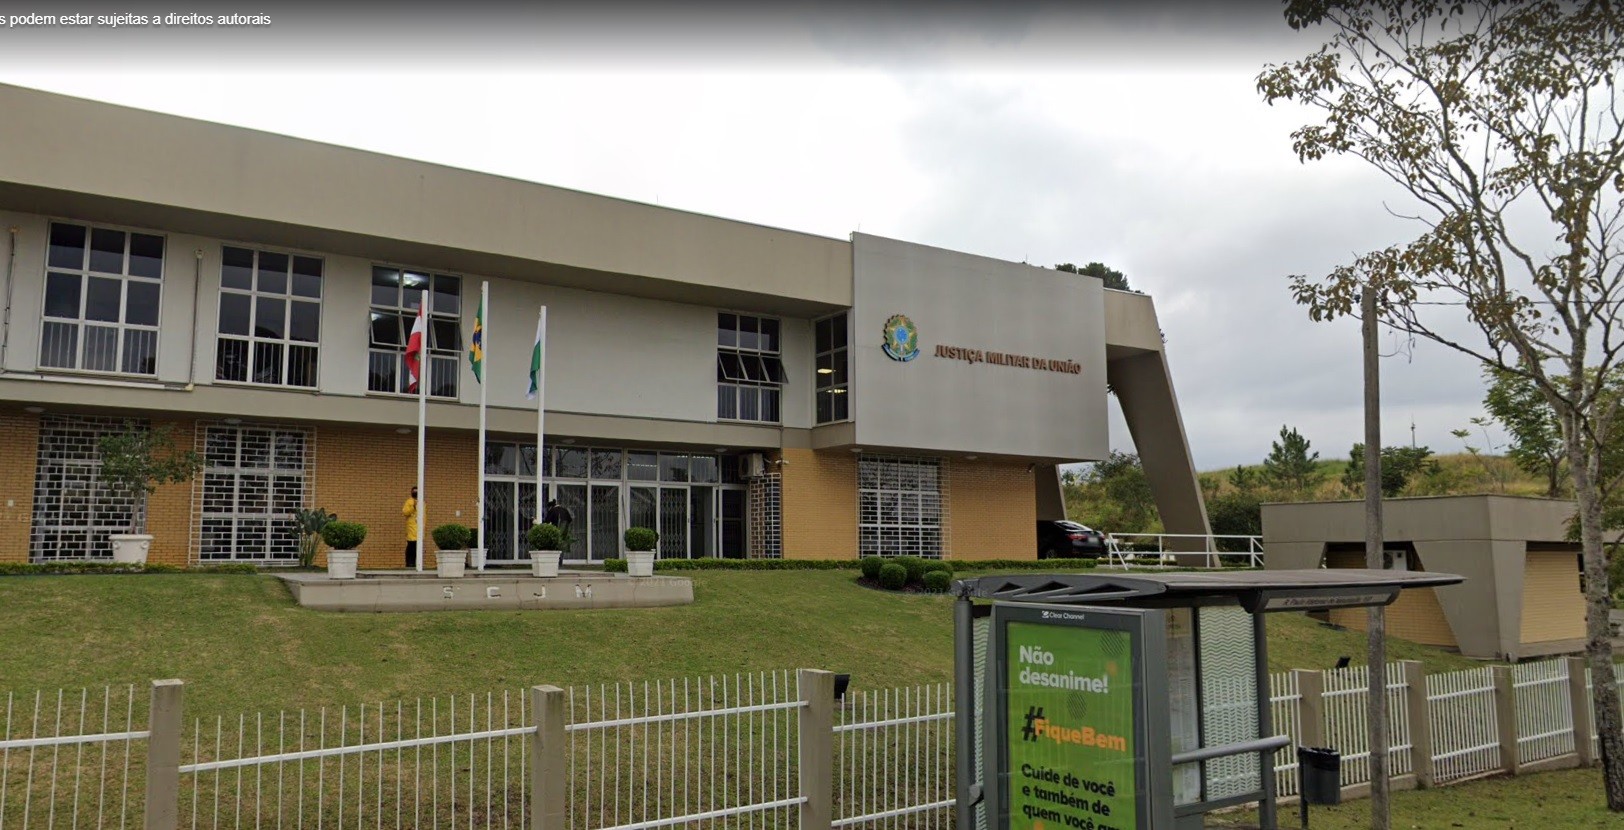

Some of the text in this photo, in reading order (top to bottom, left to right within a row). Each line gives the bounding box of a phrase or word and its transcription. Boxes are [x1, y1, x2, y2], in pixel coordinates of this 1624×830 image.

[934, 344, 1082, 375] JUSTIÇA MILITAR DA UNIÃO
[1049, 611, 1084, 620] Clear Channel
[1020, 645, 1054, 665] Não
[1020, 666, 1108, 693] desanime!
[1021, 706, 1126, 752] #FiqueBem
[1021, 763, 1115, 797] Cuide de você
[1021, 785, 1110, 816] e também de
[1022, 804, 1061, 823] quem
[1064, 813, 1095, 830] você
